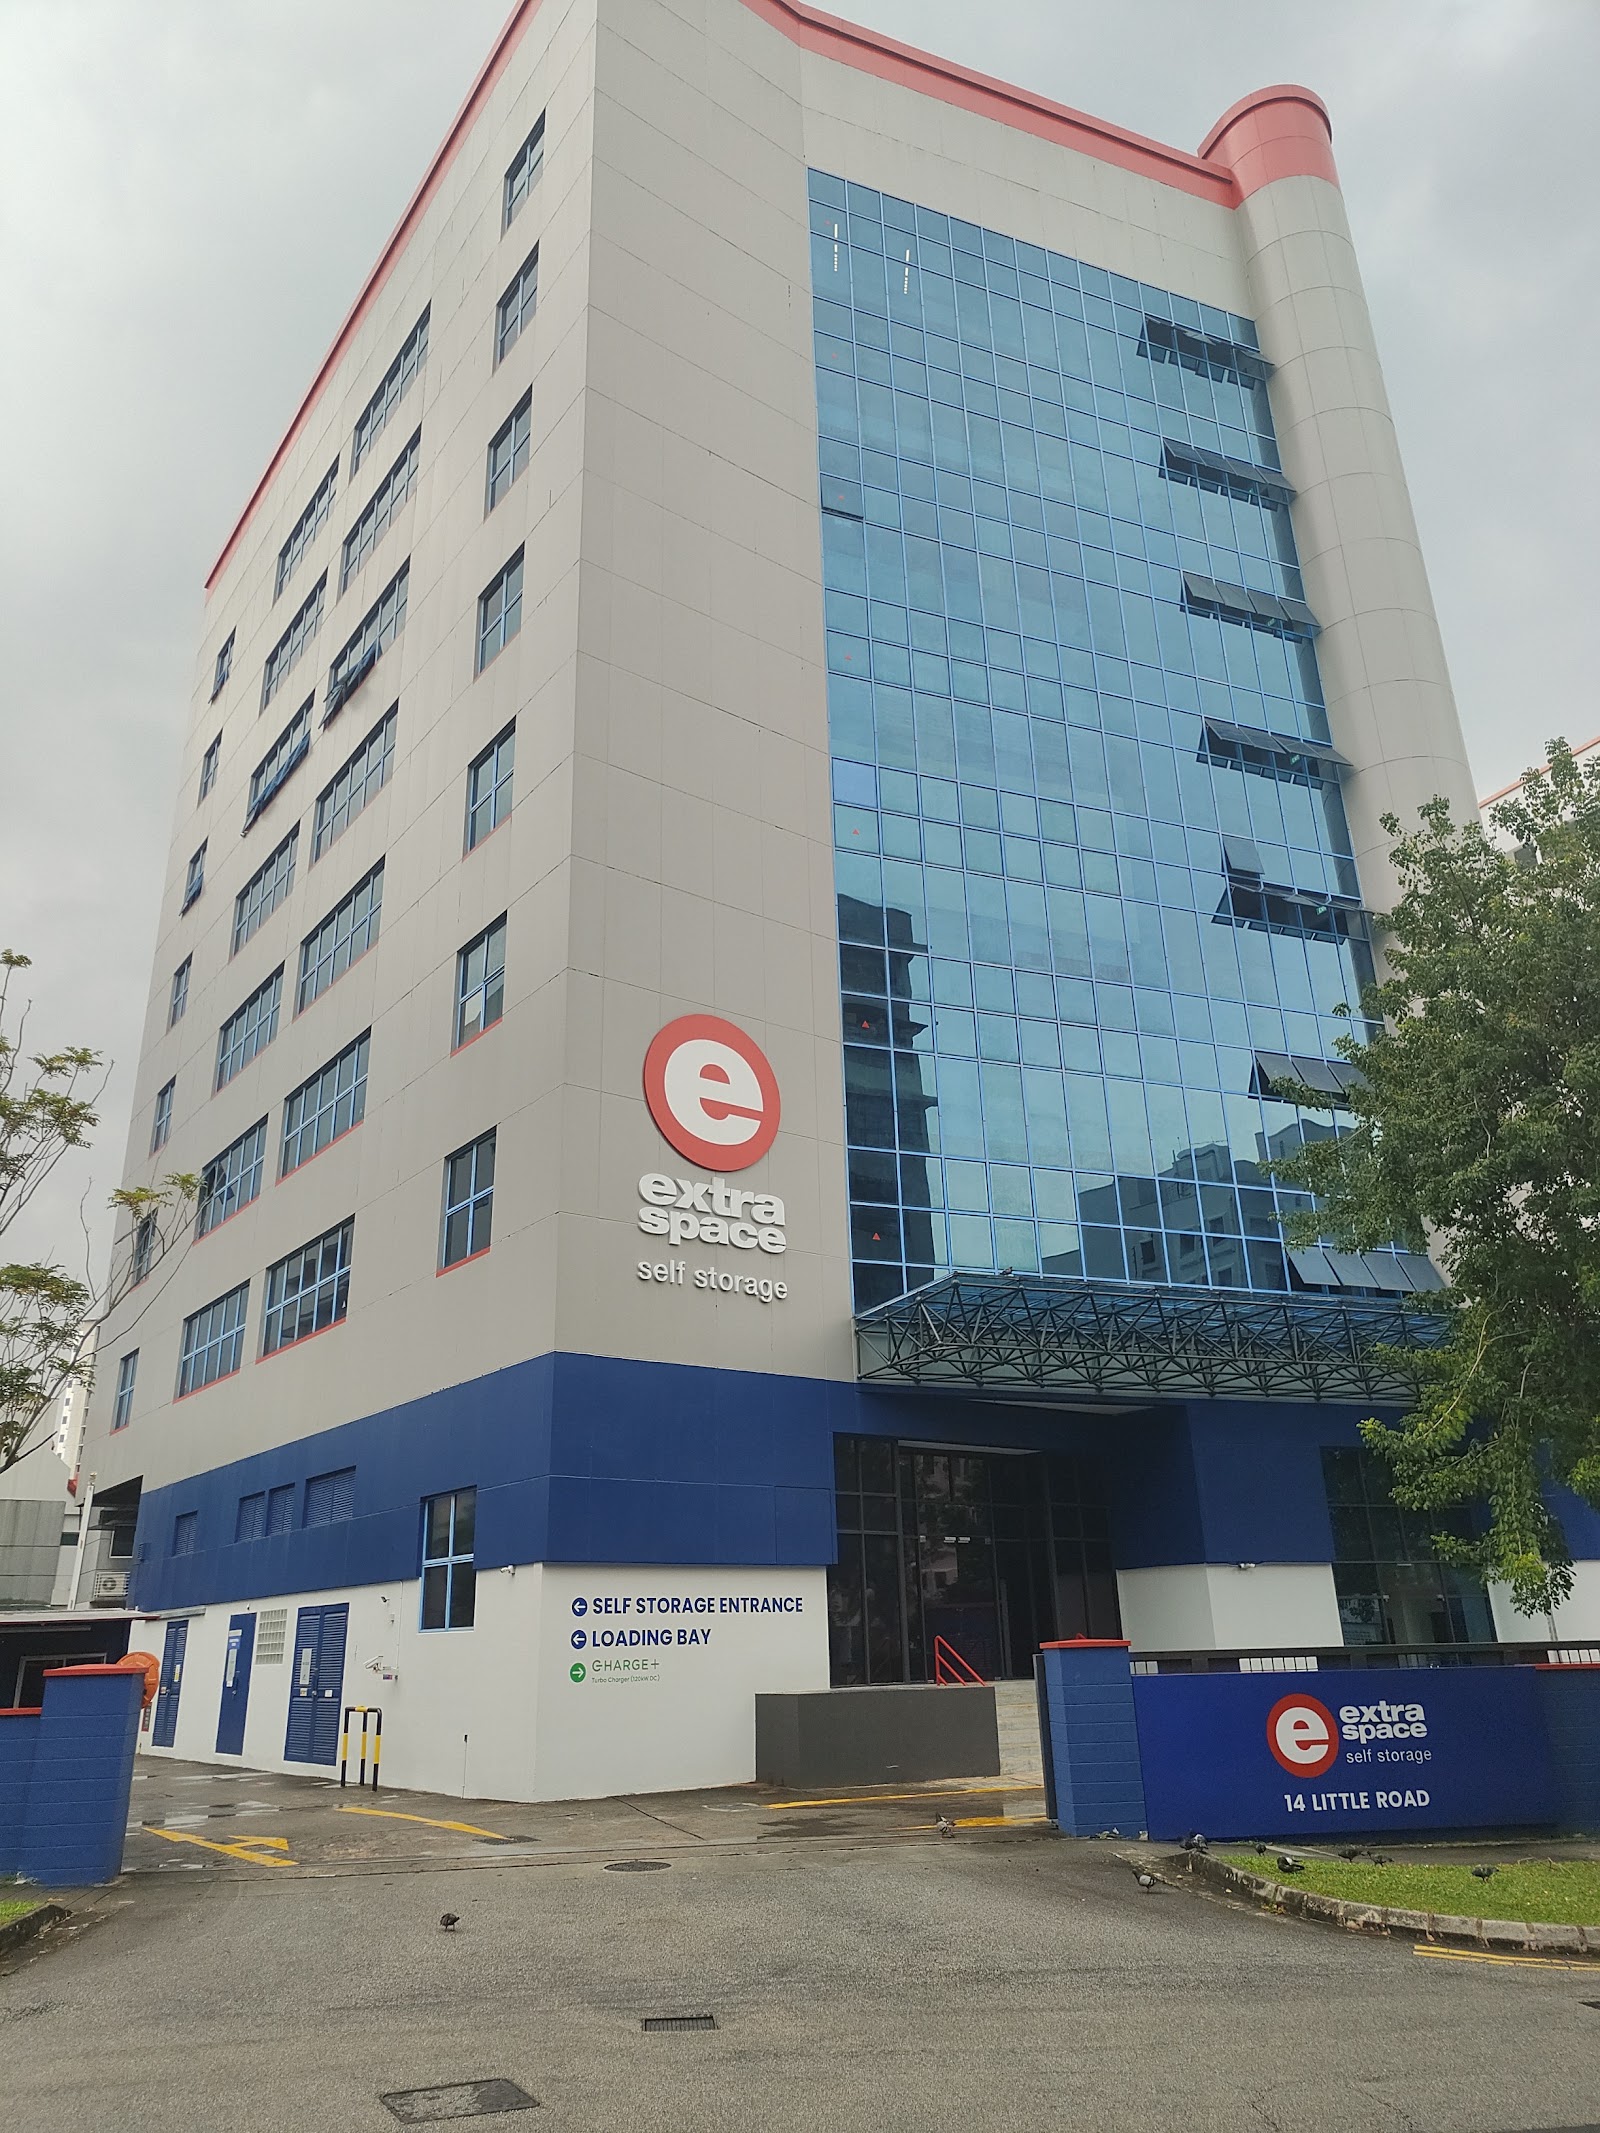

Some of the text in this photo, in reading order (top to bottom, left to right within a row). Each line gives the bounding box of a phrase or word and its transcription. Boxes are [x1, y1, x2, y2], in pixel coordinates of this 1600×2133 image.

[664, 1039, 764, 1145] e
[638, 1173, 786, 1226] extra
[638, 1206, 787, 1254] space
[637, 1260, 788, 1303] self storage
[592, 1597, 803, 1615] SELF STORAGE ENTRANCE
[592, 1628, 712, 1648] LOADING BAY
[608, 1676, 630, 1684] Charger
[1339, 1700, 1426, 1723] extra
[1275, 1706, 1330, 1765] e
[1342, 1722, 1428, 1744] space
[1346, 1748, 1432, 1764] self storage
[1284, 1789, 1431, 1812] 14 LITTLE ROAD
